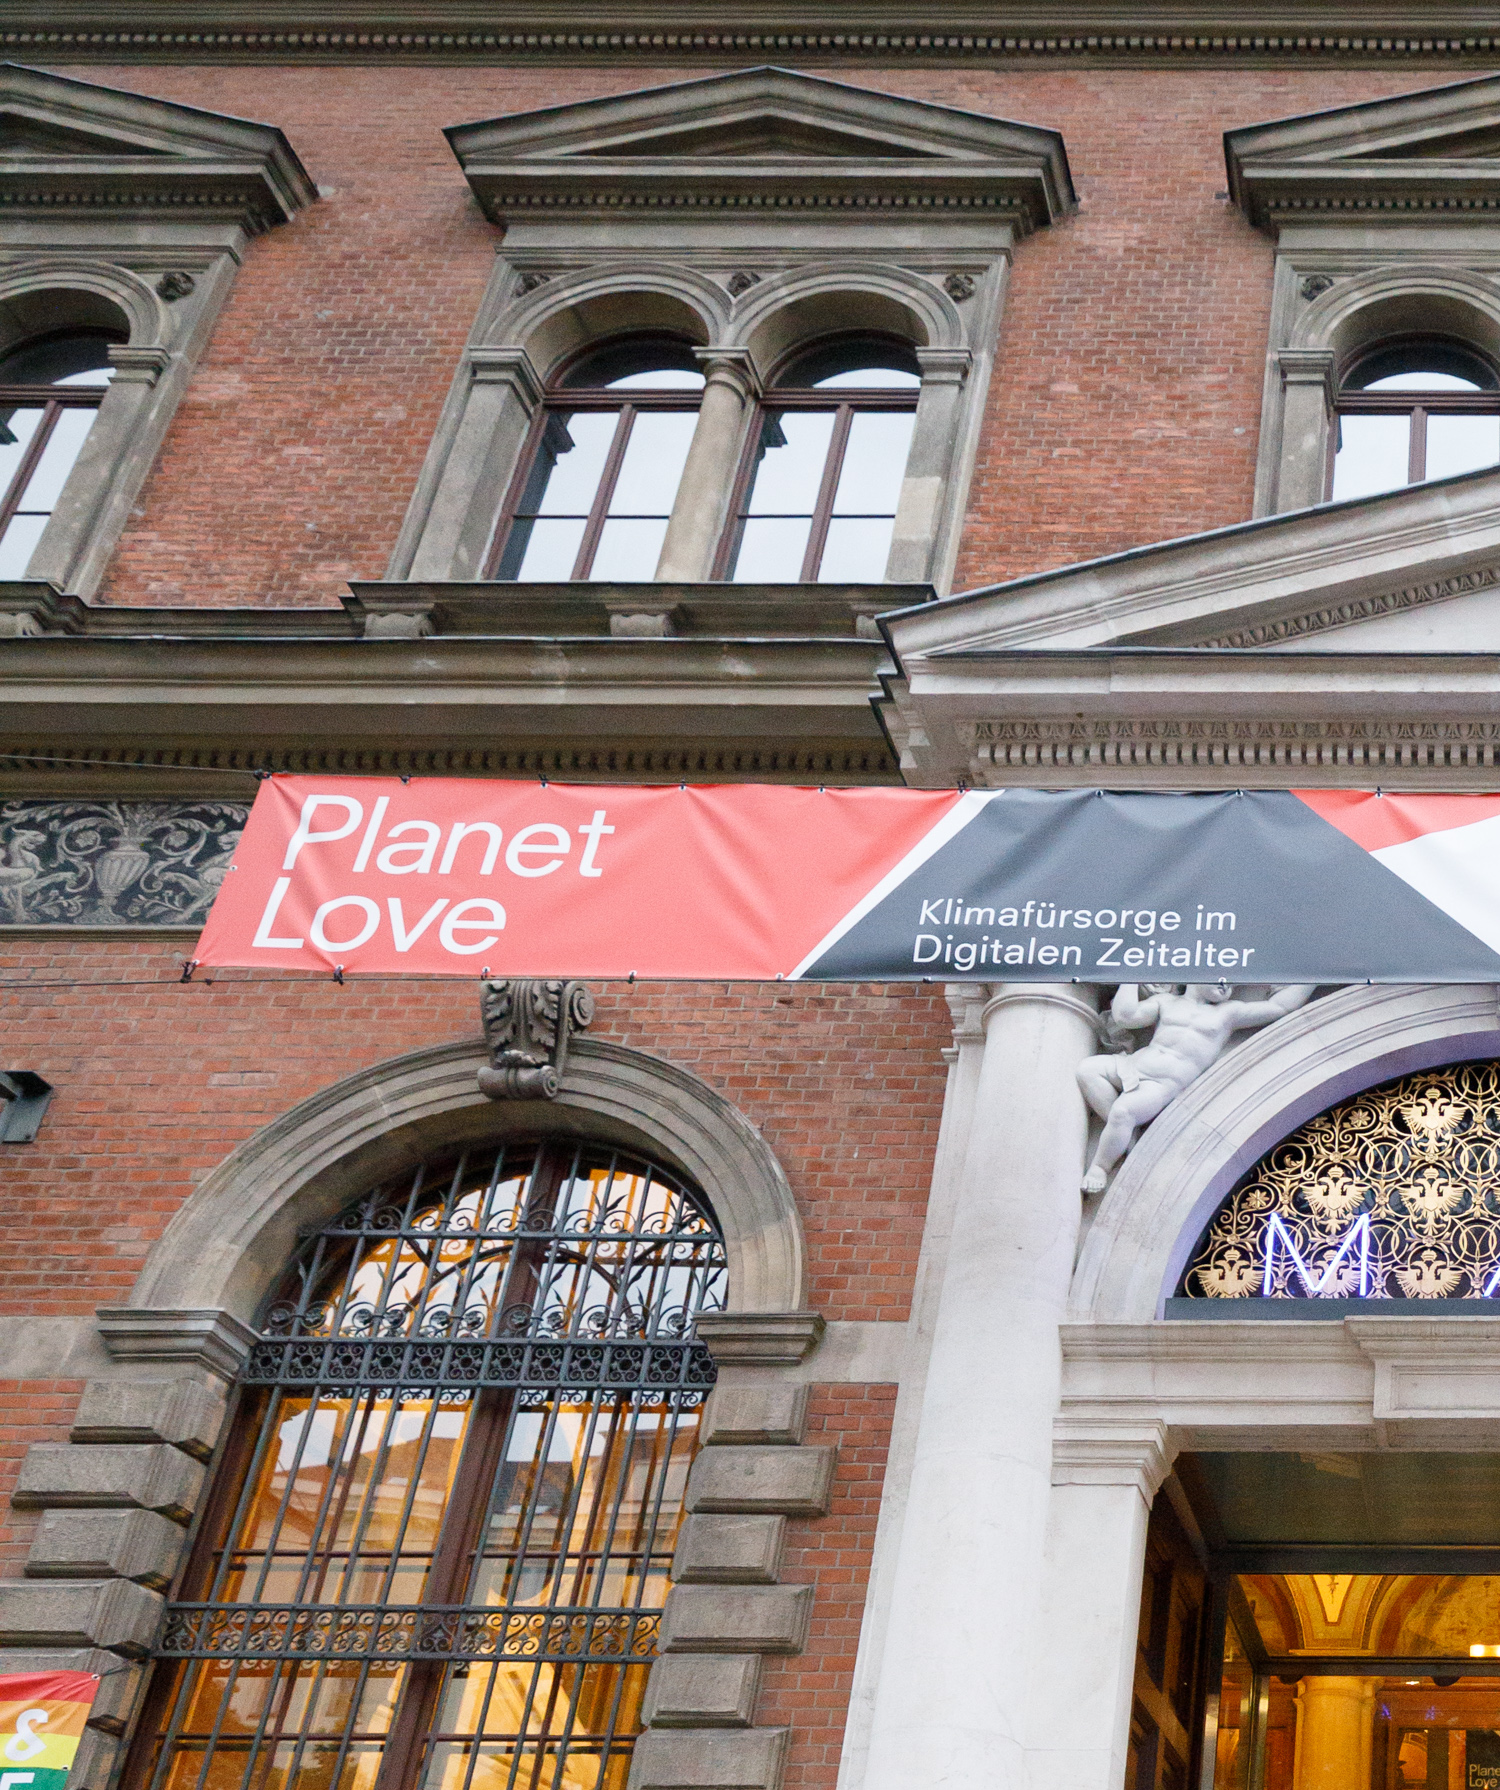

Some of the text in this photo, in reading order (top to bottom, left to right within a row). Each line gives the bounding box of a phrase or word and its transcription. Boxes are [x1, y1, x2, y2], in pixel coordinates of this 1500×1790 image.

[283, 794, 615, 879] Planet
[252, 876, 507, 955] Love
[918, 898, 1237, 932] Klimafürsorge im
[912, 933, 1256, 972] Digitalen Zeitalter
[4, 1708, 49, 1762] &
[1469, 1776, 1498, 1788] Love
